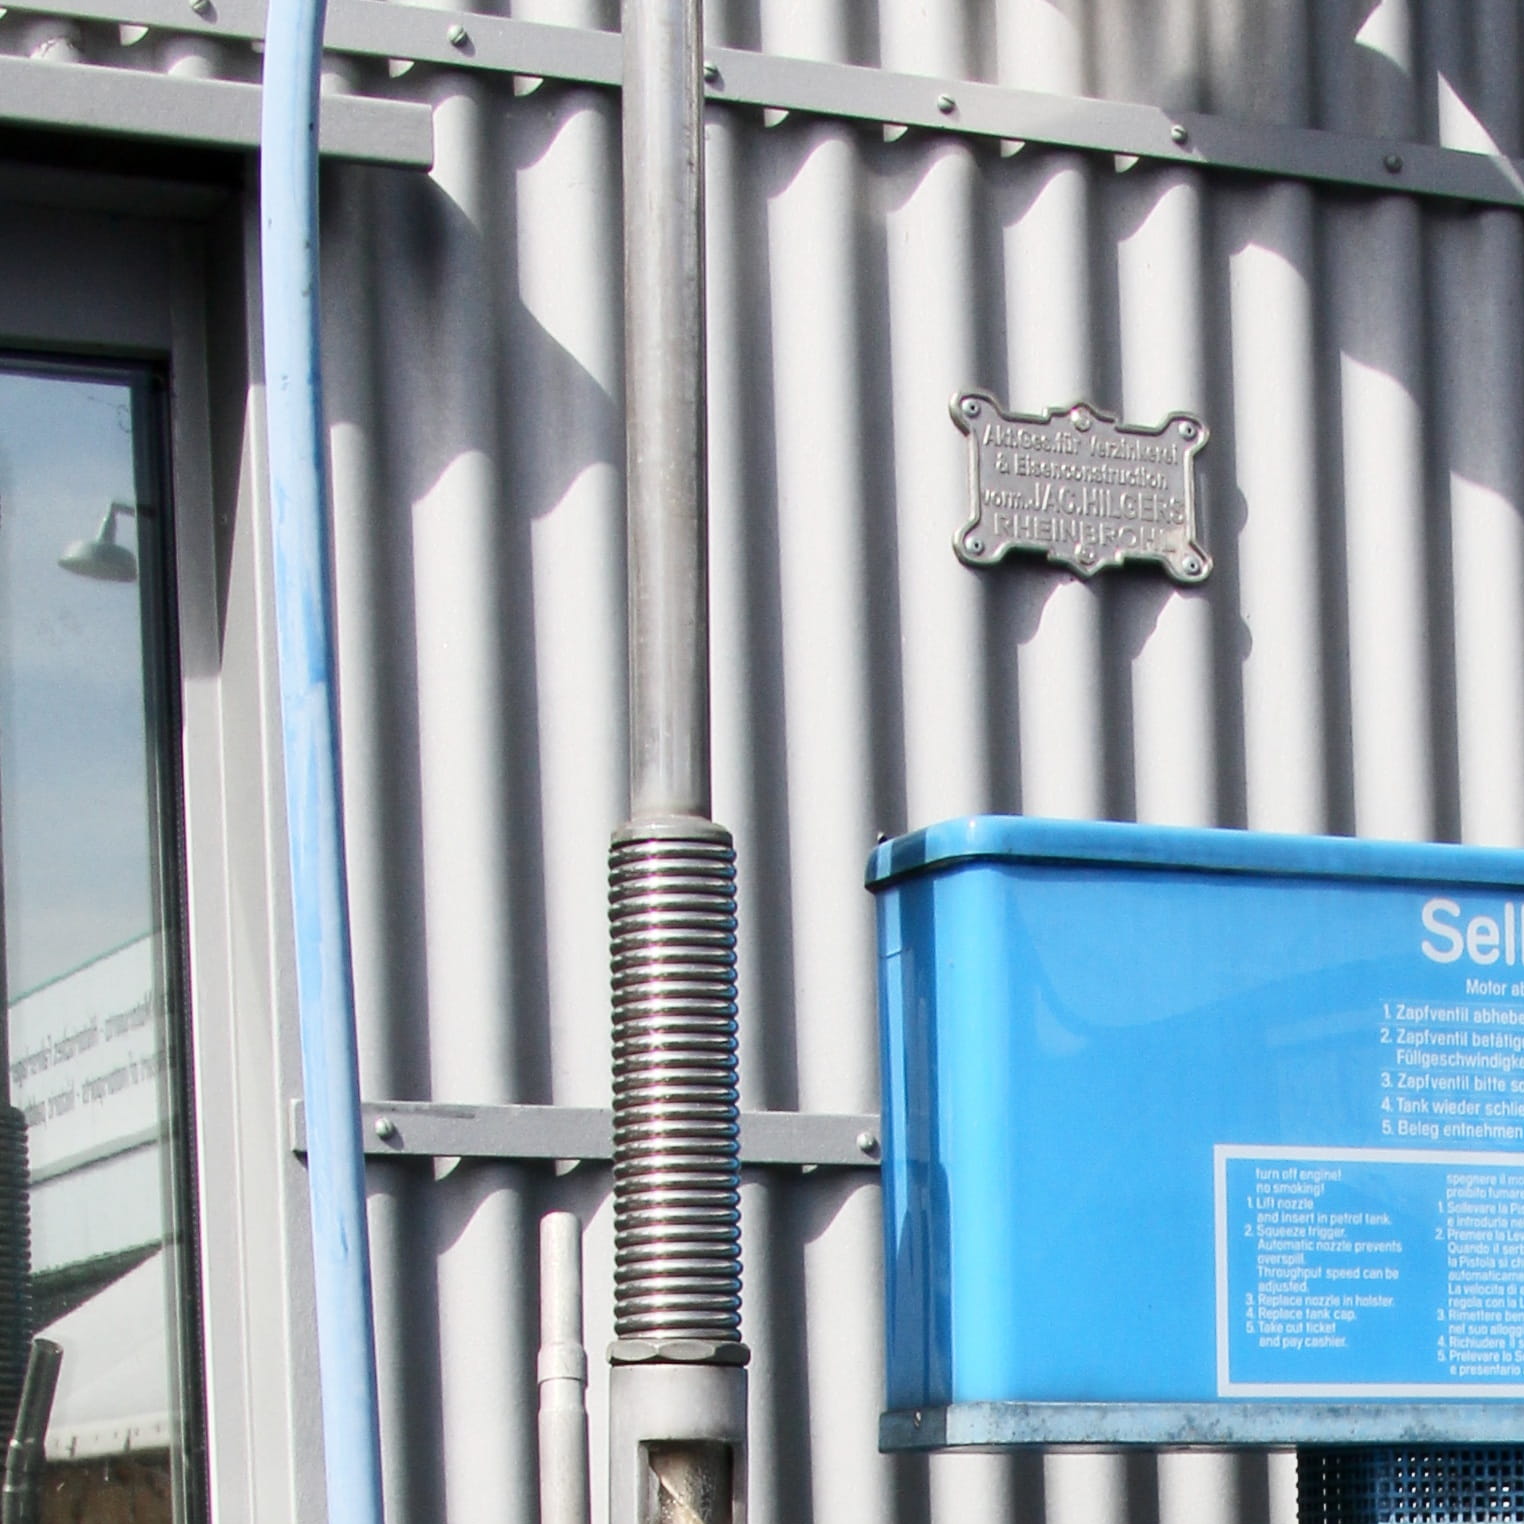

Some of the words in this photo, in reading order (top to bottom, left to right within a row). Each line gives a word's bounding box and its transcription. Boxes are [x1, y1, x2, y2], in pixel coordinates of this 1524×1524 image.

[993, 513, 1175, 553] RHEINBROHL
[1466, 979, 1505, 996] Motor
[1396, 1004, 1468, 1022] Zapfventil
[1397, 1029, 1468, 1047] Zapfventil
[1398, 1073, 1469, 1091] Zapfventil
[1474, 1075, 1505, 1092] bitte
[1396, 1098, 1428, 1113] Tank
[1433, 1099, 1479, 1115] wieder
[1398, 1120, 1439, 1139] Beleg
[1444, 1122, 1523, 1140] entnehmen
